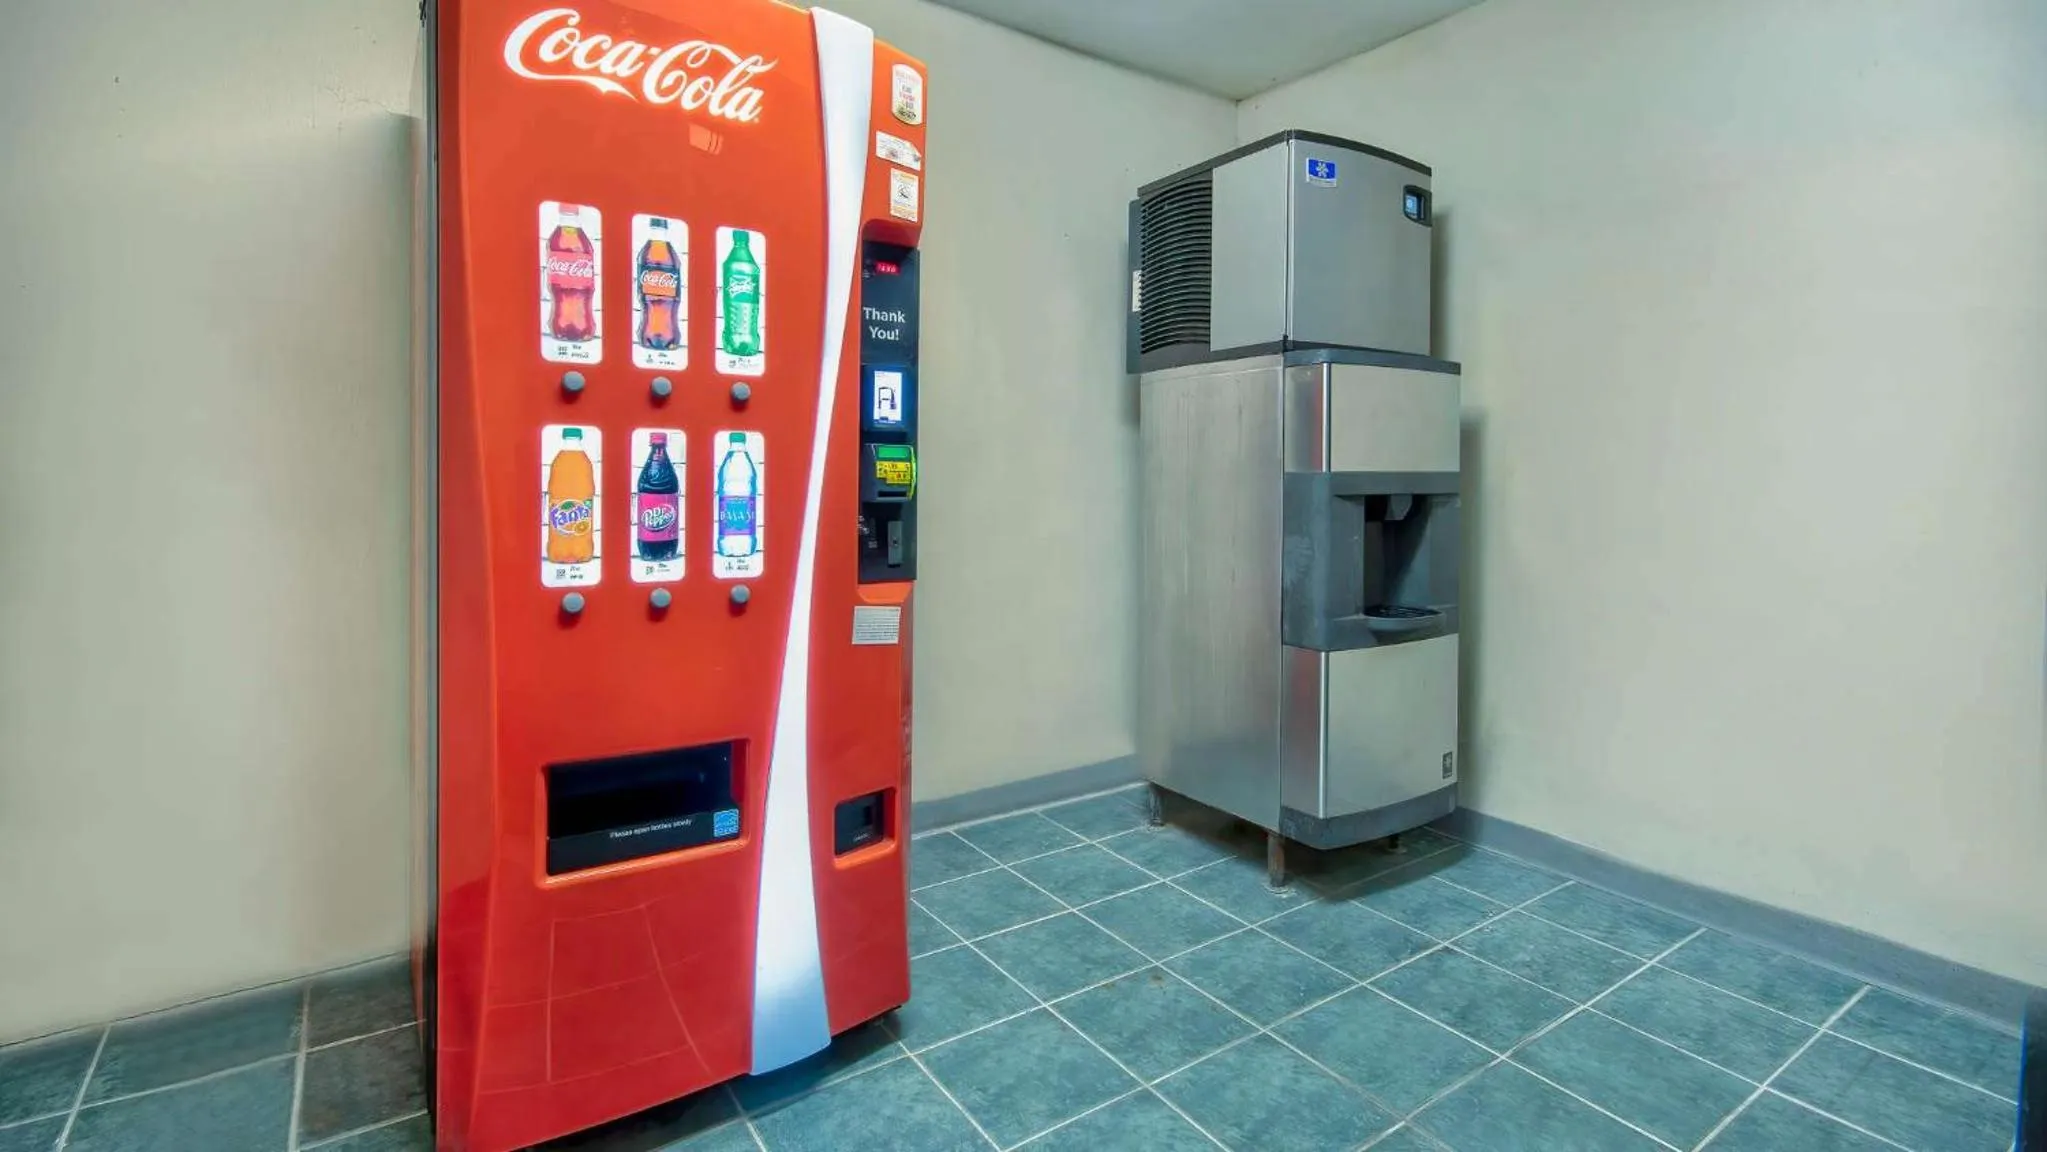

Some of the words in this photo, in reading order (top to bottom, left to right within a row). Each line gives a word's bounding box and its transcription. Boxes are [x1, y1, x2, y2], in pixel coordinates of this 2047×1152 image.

[503, 7, 778, 122] Coca-Cola
[863, 306, 906, 323] Thank
[869, 325, 900, 341] You!
